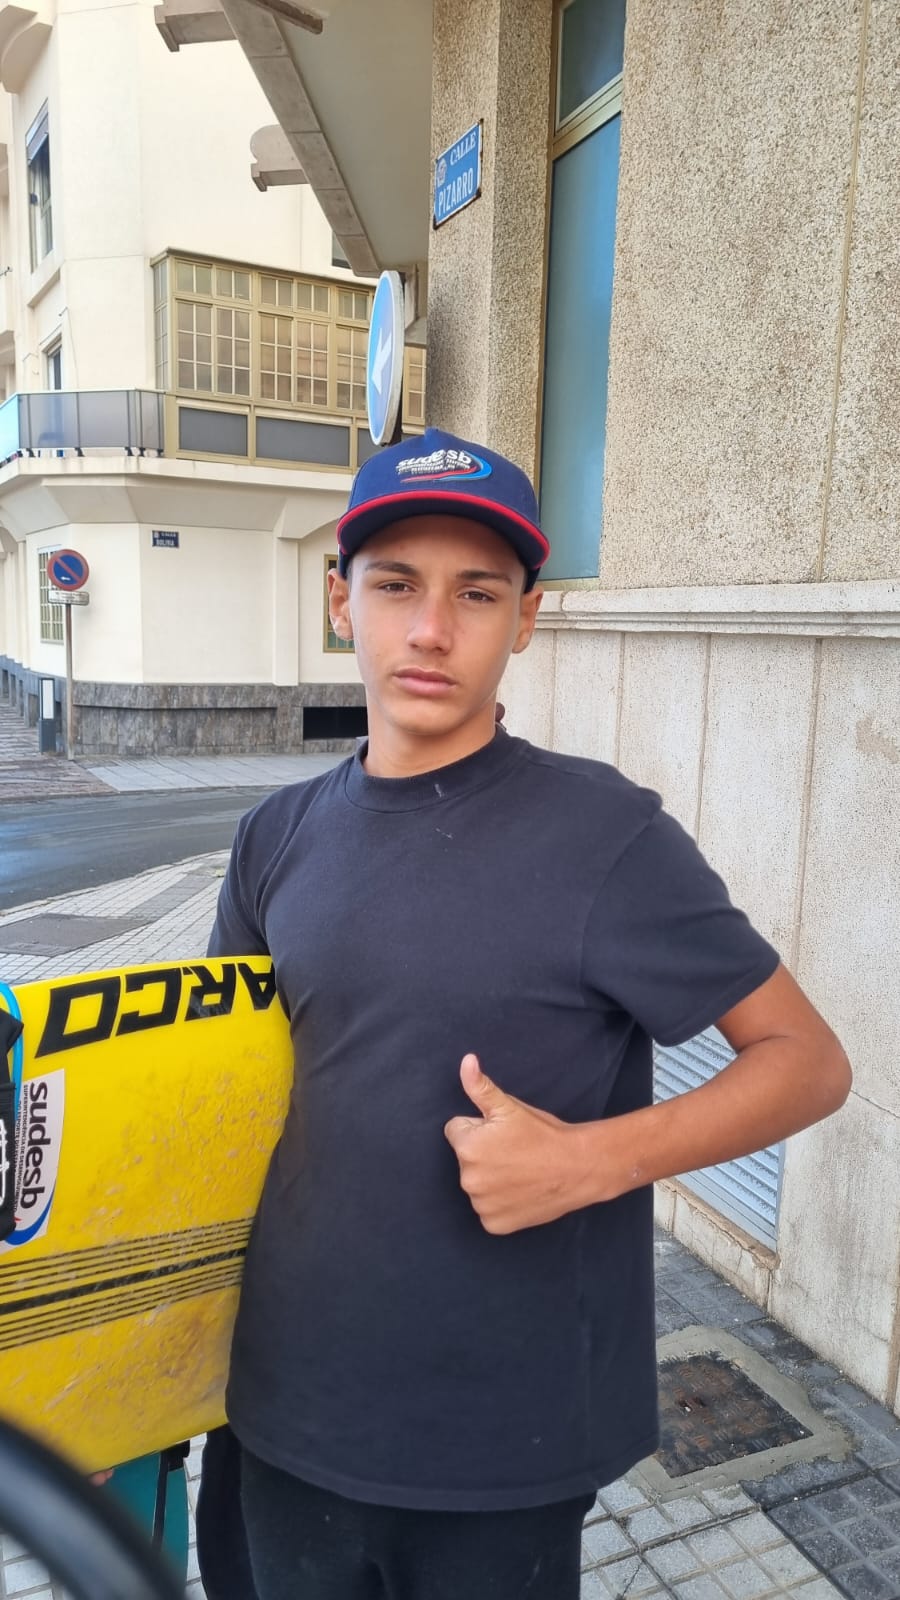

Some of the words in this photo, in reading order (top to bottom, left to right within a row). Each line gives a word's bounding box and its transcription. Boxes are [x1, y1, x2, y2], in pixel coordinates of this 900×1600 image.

[450, 131, 477, 166] CALLE
[438, 167, 474, 217] PIZARRO
[34, 963, 277, 1059] ARCO
[20, 1081, 51, 1209] sudesb
